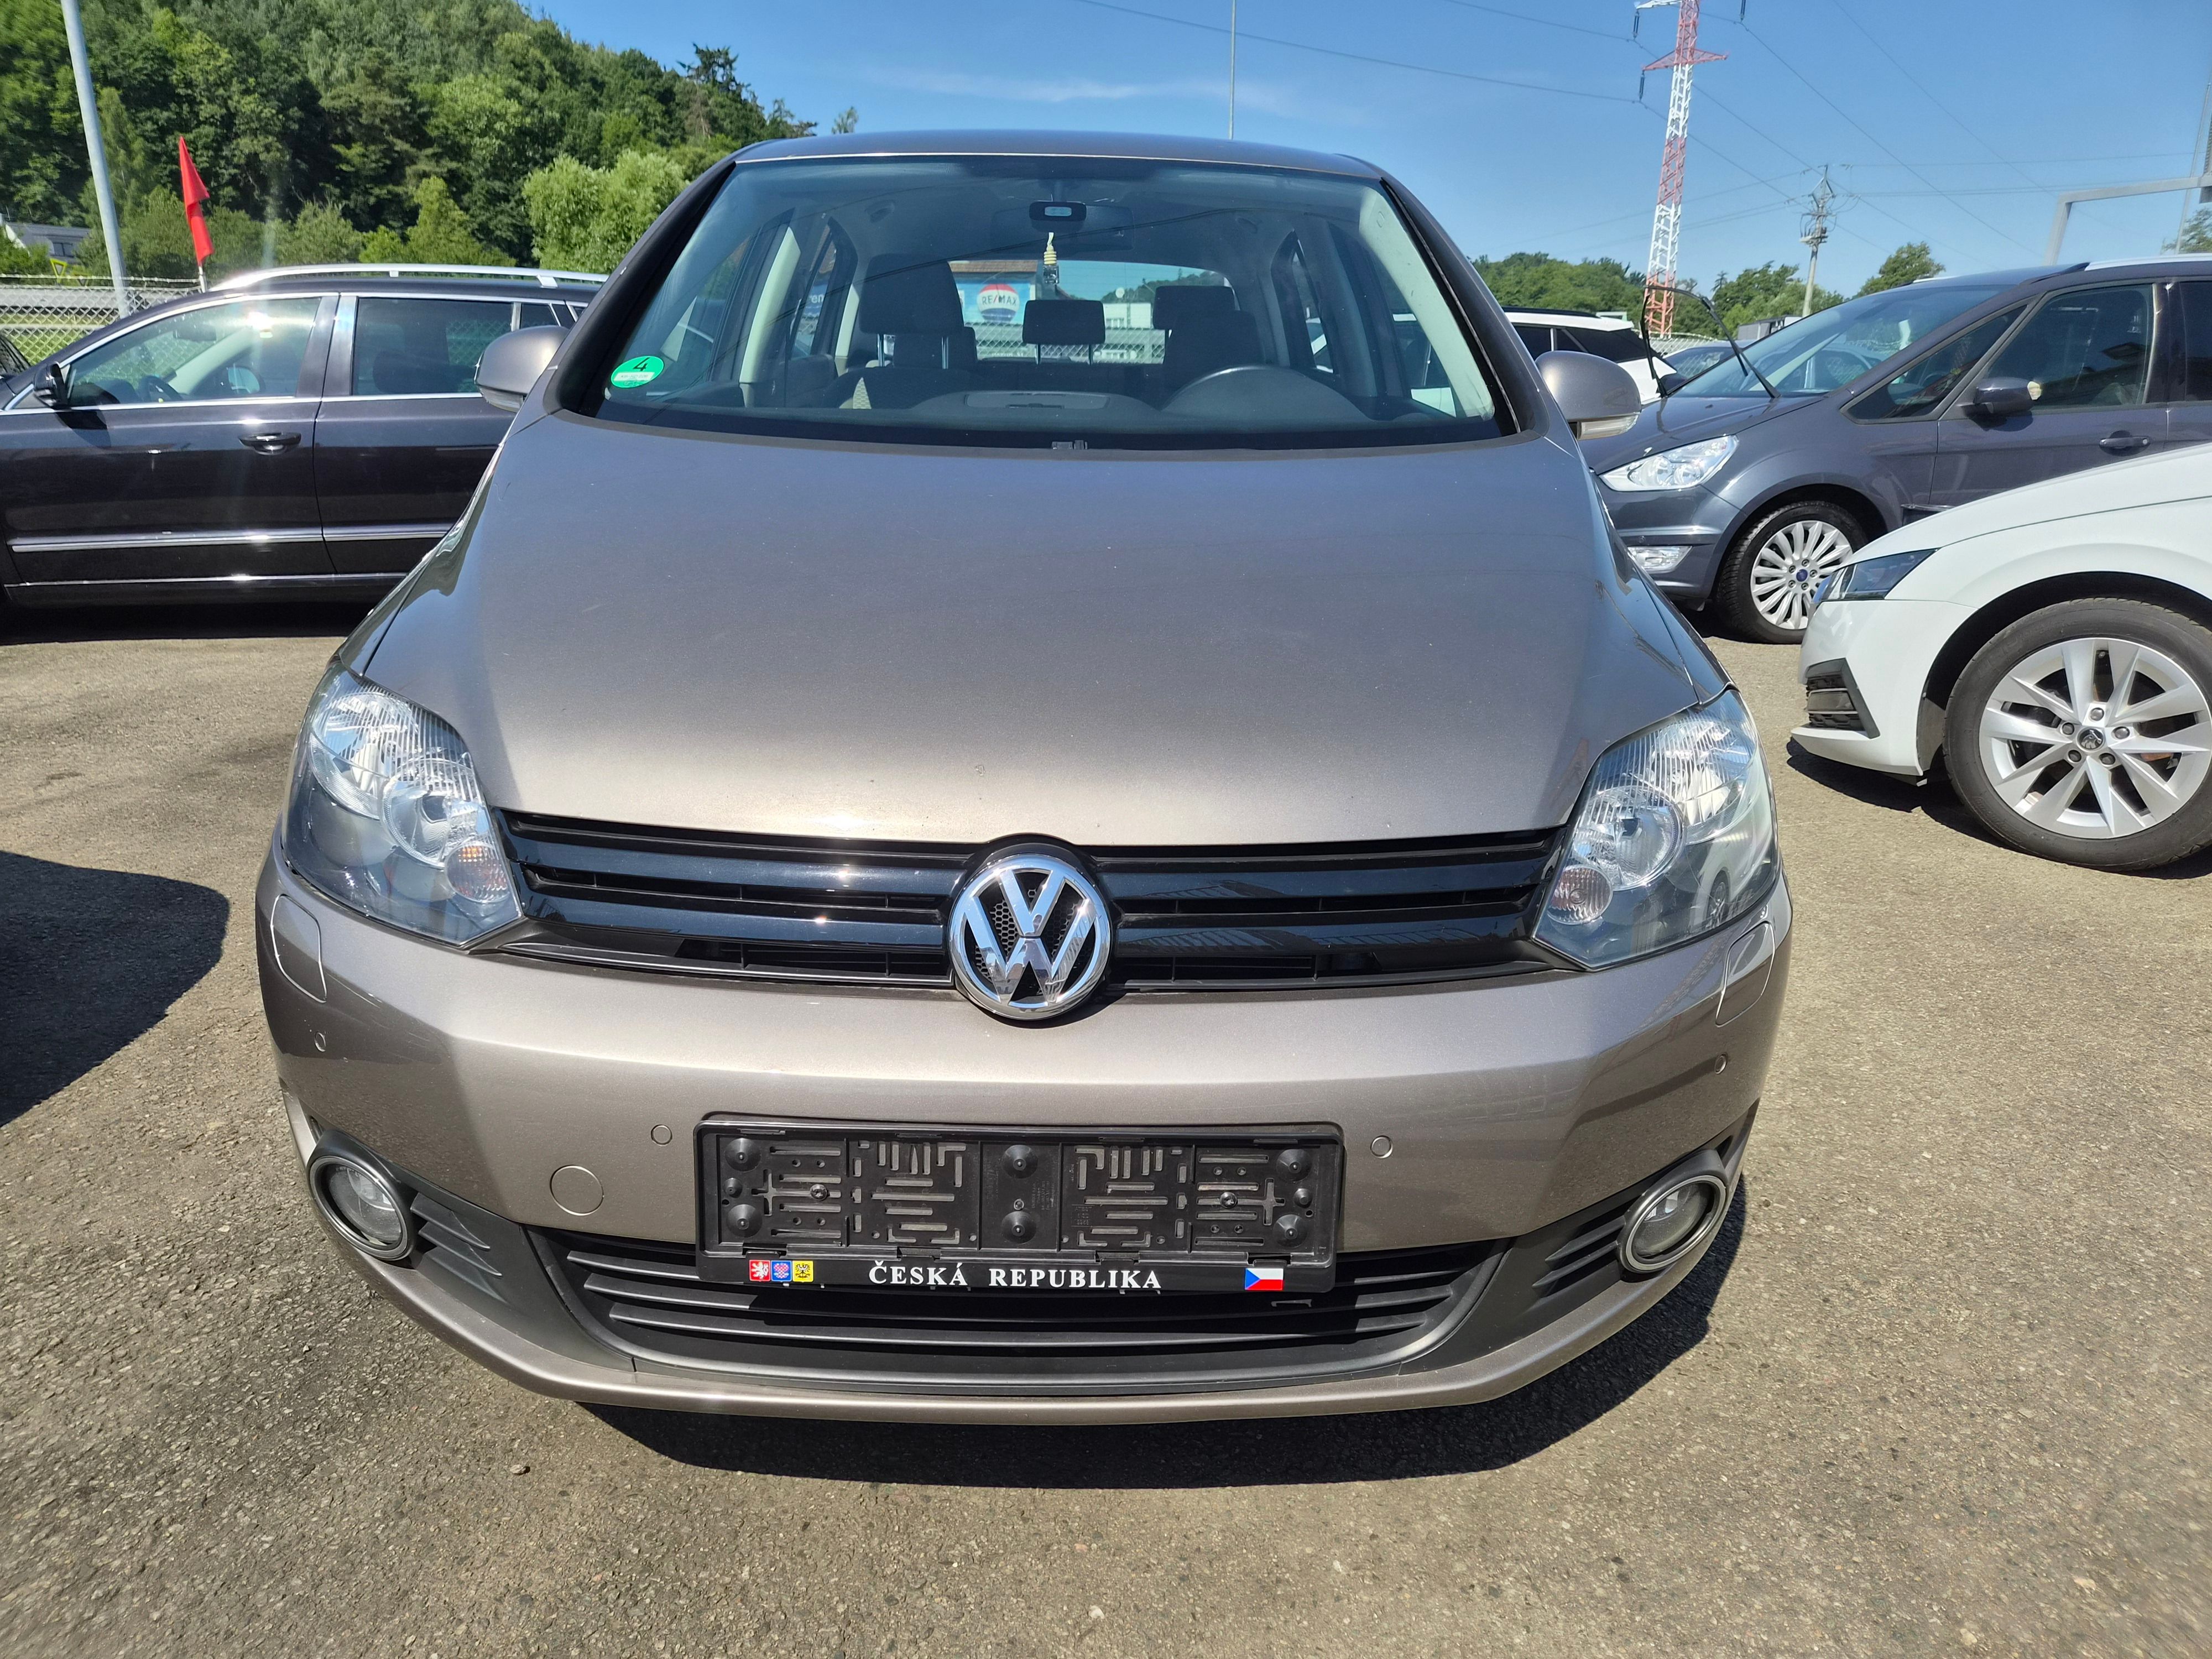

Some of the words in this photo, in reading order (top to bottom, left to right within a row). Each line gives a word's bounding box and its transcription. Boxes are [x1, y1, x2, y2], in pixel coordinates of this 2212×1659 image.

[982, 295, 1017, 306] RE/MAX
[633, 357, 650, 371] 4
[868, 1260, 968, 1286] ČESKÁ
[988, 1268, 1162, 1289] REPUBLIKA
